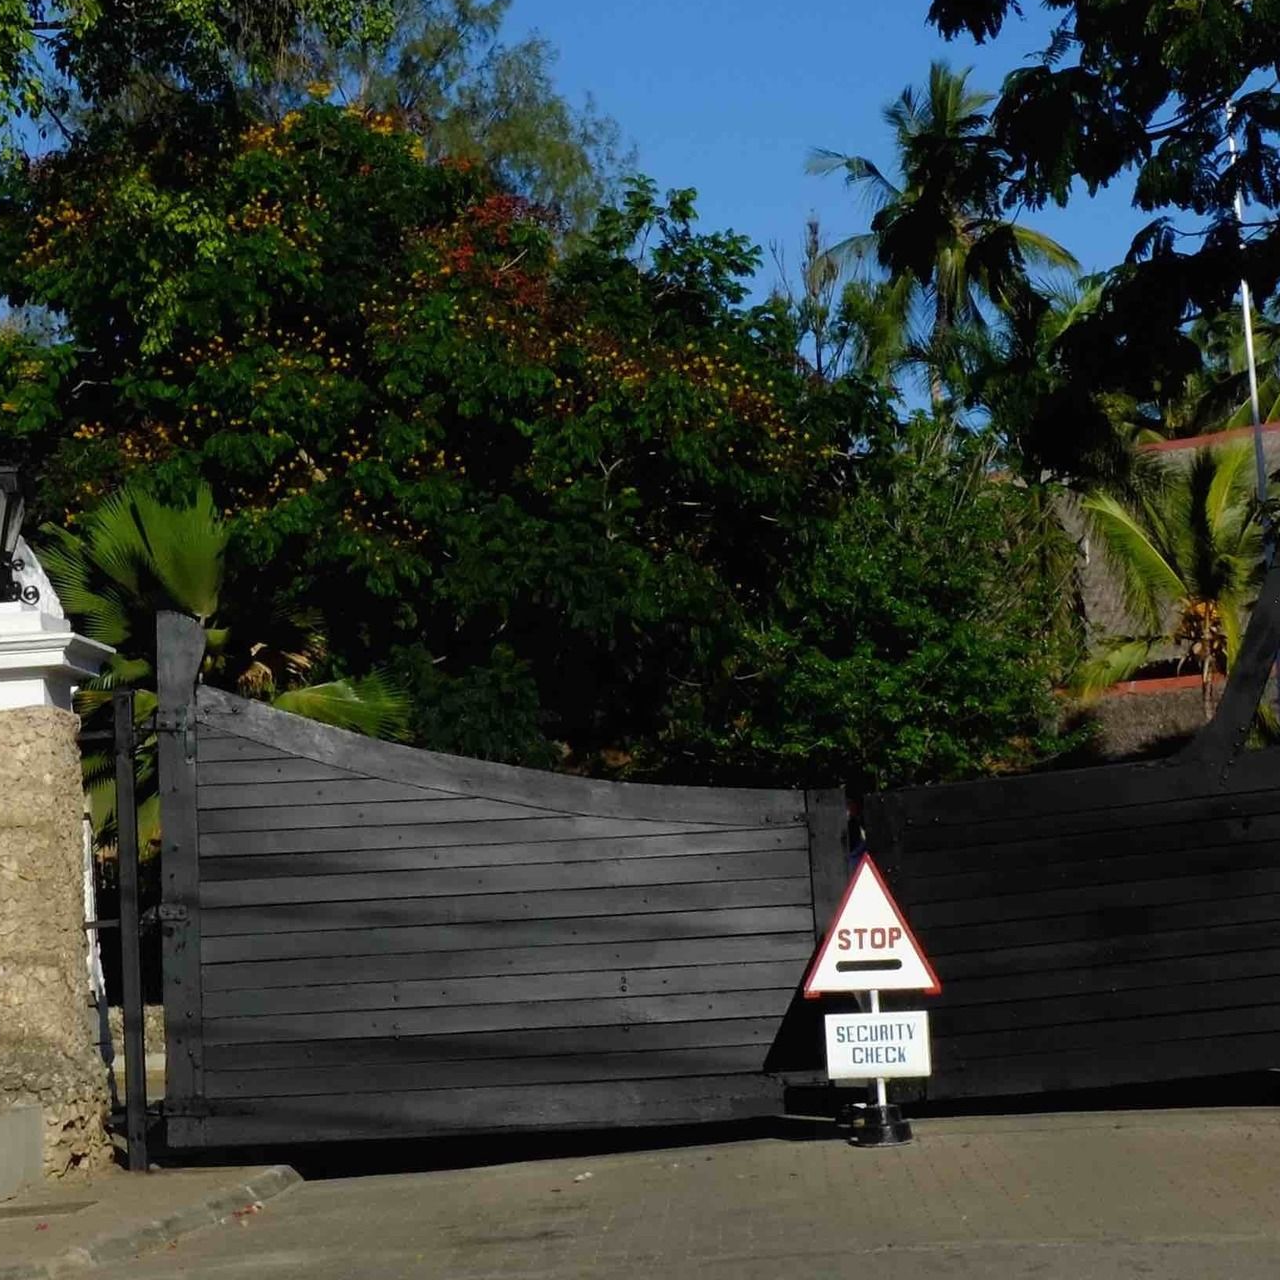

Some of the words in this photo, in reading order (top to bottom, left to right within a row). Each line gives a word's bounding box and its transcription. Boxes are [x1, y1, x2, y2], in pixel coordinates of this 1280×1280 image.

[838, 927, 902, 950] STOP
[836, 1023, 916, 1043] SECURITY
[852, 1046, 907, 1064] CHECK
